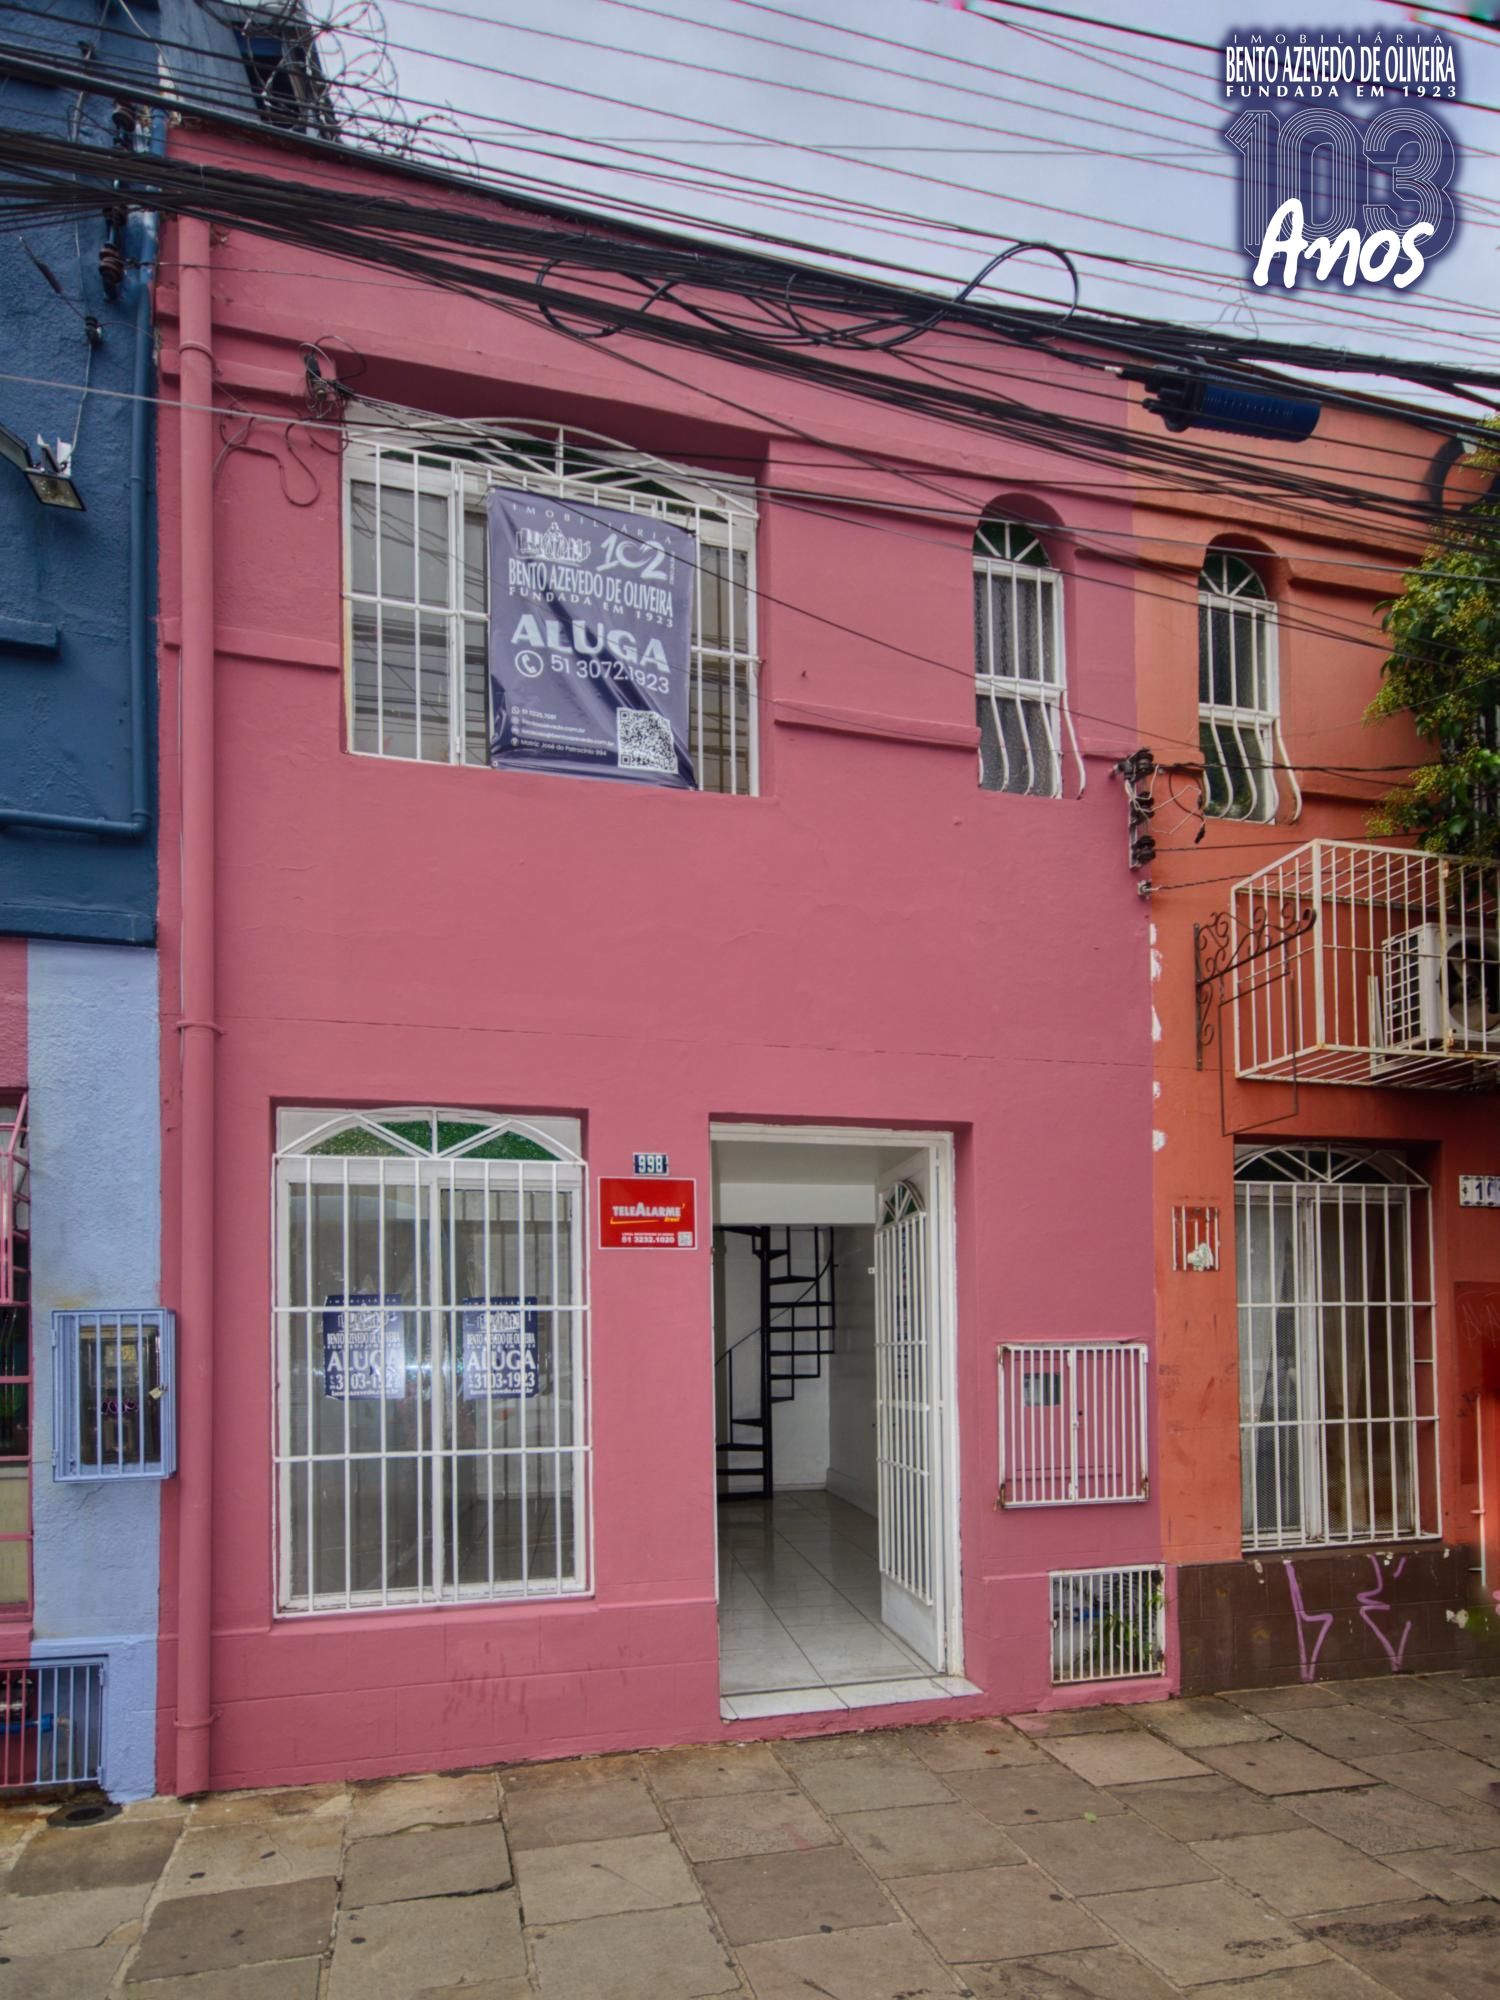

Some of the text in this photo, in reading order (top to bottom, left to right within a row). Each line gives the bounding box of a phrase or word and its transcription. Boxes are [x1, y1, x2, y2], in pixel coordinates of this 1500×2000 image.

[512, 503, 672, 544] IMOBILIÁRIA
[508, 557, 674, 618] BENTO AZEVEDO DE OLIVEIRA
[508, 586, 673, 628] FUNDADA EM 1923
[510, 613, 671, 674] ALUGA
[550, 654, 670, 694] 51 3072.1923
[638, 1155, 663, 1173] 998
[467, 1350, 537, 1371] ALUGA
[475, 1372, 536, 1388] 3103-123
